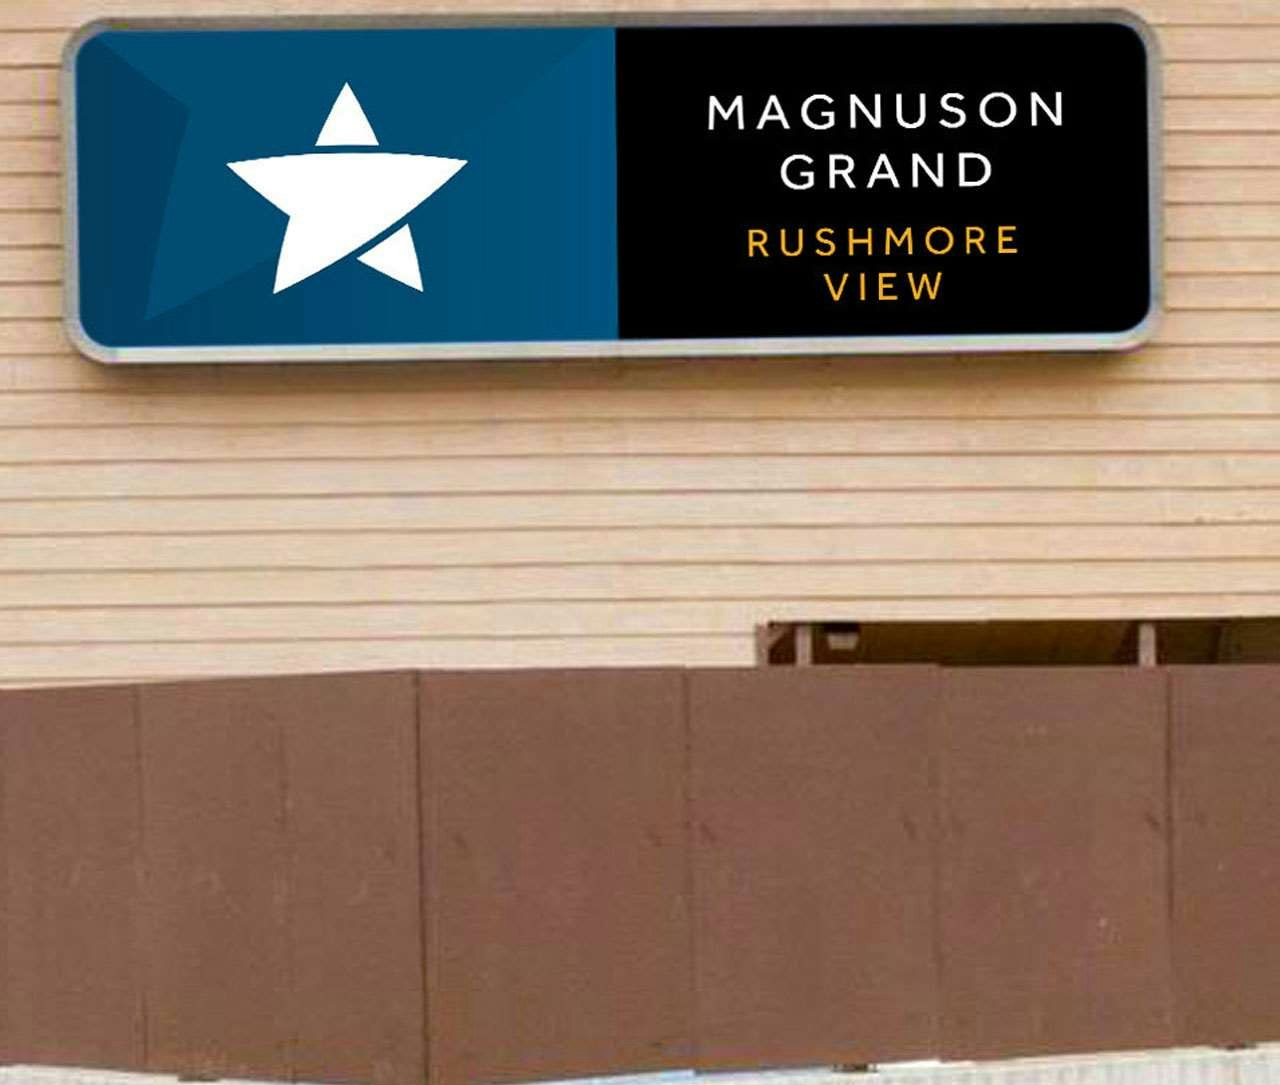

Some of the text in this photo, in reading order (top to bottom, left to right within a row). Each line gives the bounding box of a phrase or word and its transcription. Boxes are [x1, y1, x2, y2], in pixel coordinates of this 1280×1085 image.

[707, 91, 1064, 131] MAGNUSON
[780, 152, 993, 190] GRAND
[747, 225, 1019, 257] RUSHMORE
[822, 271, 944, 302] VIEW
